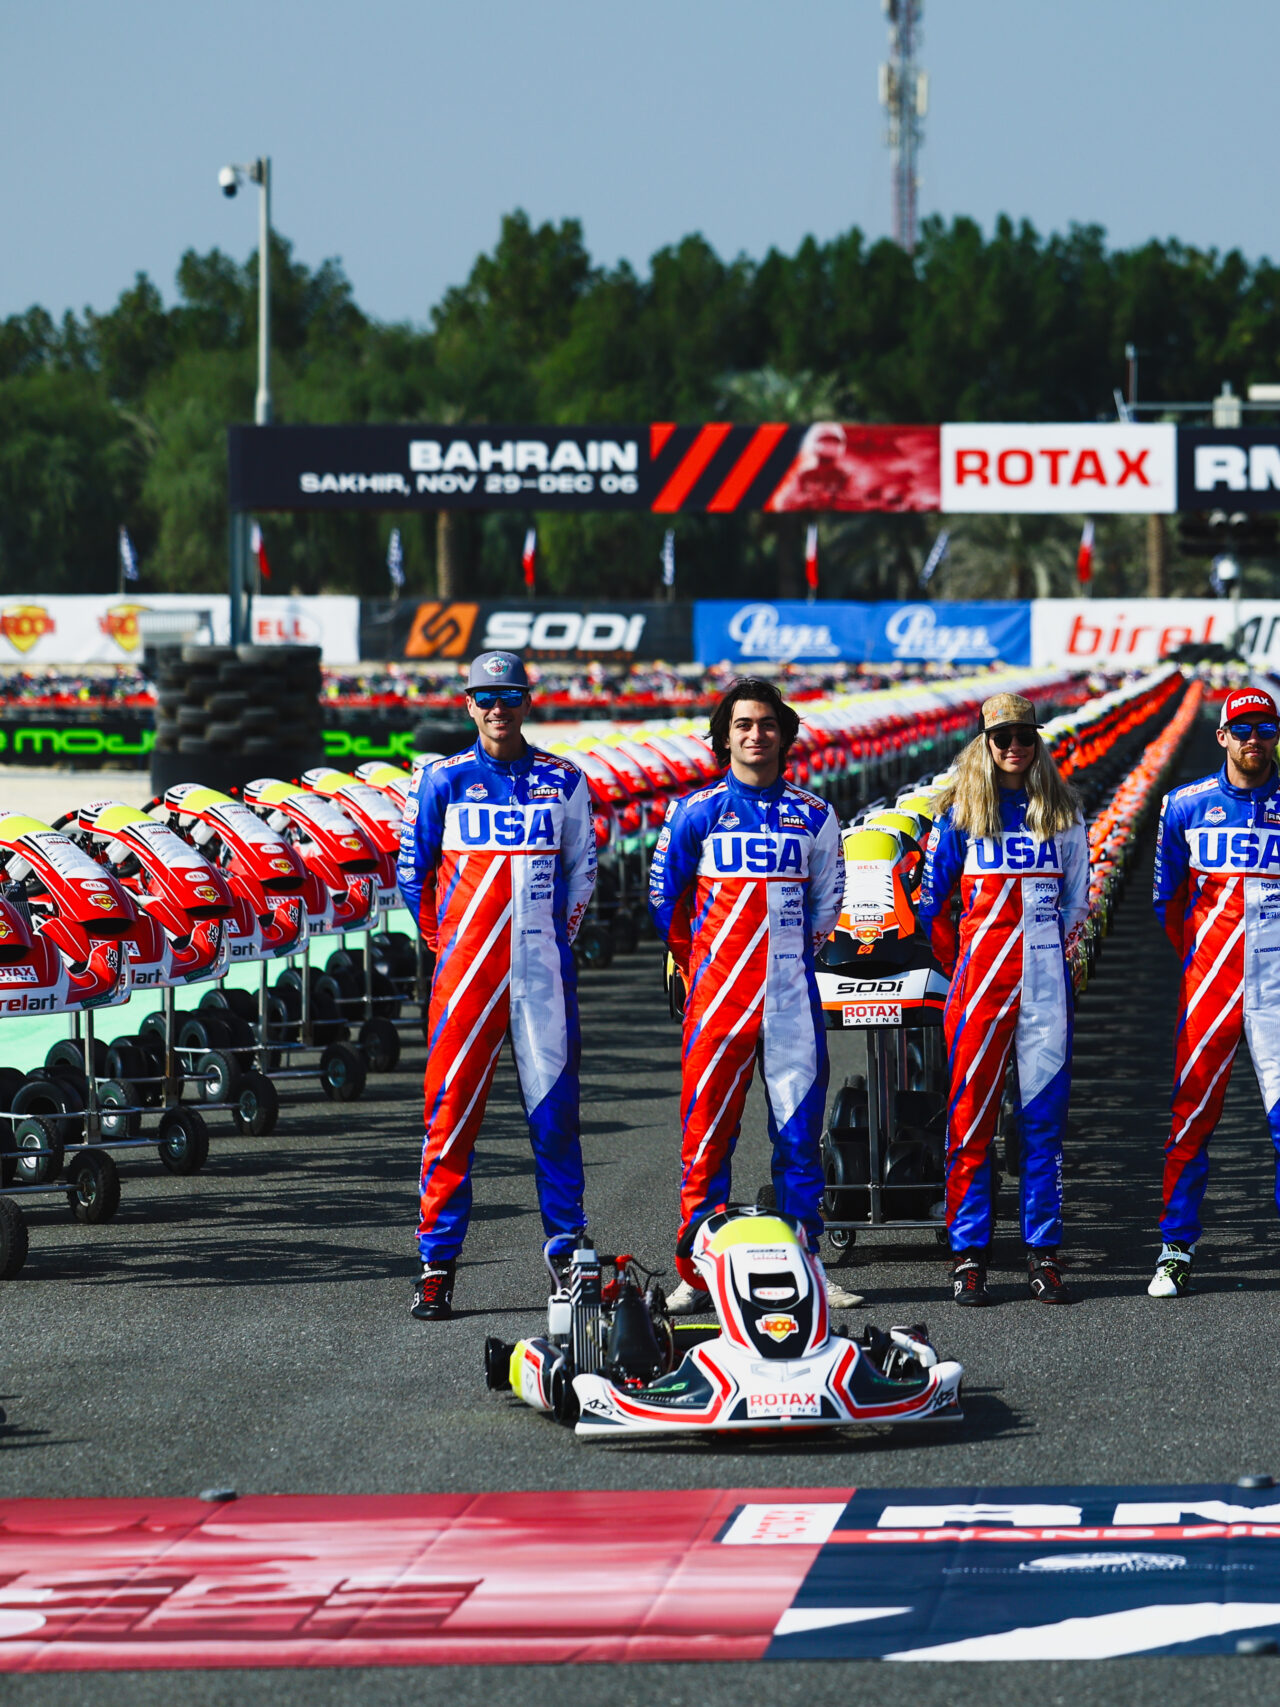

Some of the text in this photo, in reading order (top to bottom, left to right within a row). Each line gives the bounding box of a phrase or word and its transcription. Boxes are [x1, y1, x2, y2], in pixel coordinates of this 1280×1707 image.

[409, 440, 638, 472] BAHRAIN
[955, 449, 1150, 486] ROTAX
[300, 474, 409, 497] SAKHIR,
[417, 474, 476, 493] NOV
[600, 474, 638, 493] 06
[258, 619, 309, 639] ELL
[1231, 694, 1271, 710] ROTAX
[458, 808, 555, 846] USA
[782, 816, 806, 825] RMC
[712, 838, 802, 874] USA
[976, 837, 1059, 869] USA
[844, 1005, 899, 1018] ROTAX
[750, 1393, 817, 1407] ROTAX
[867, 1528, 1155, 1541] GRAND
